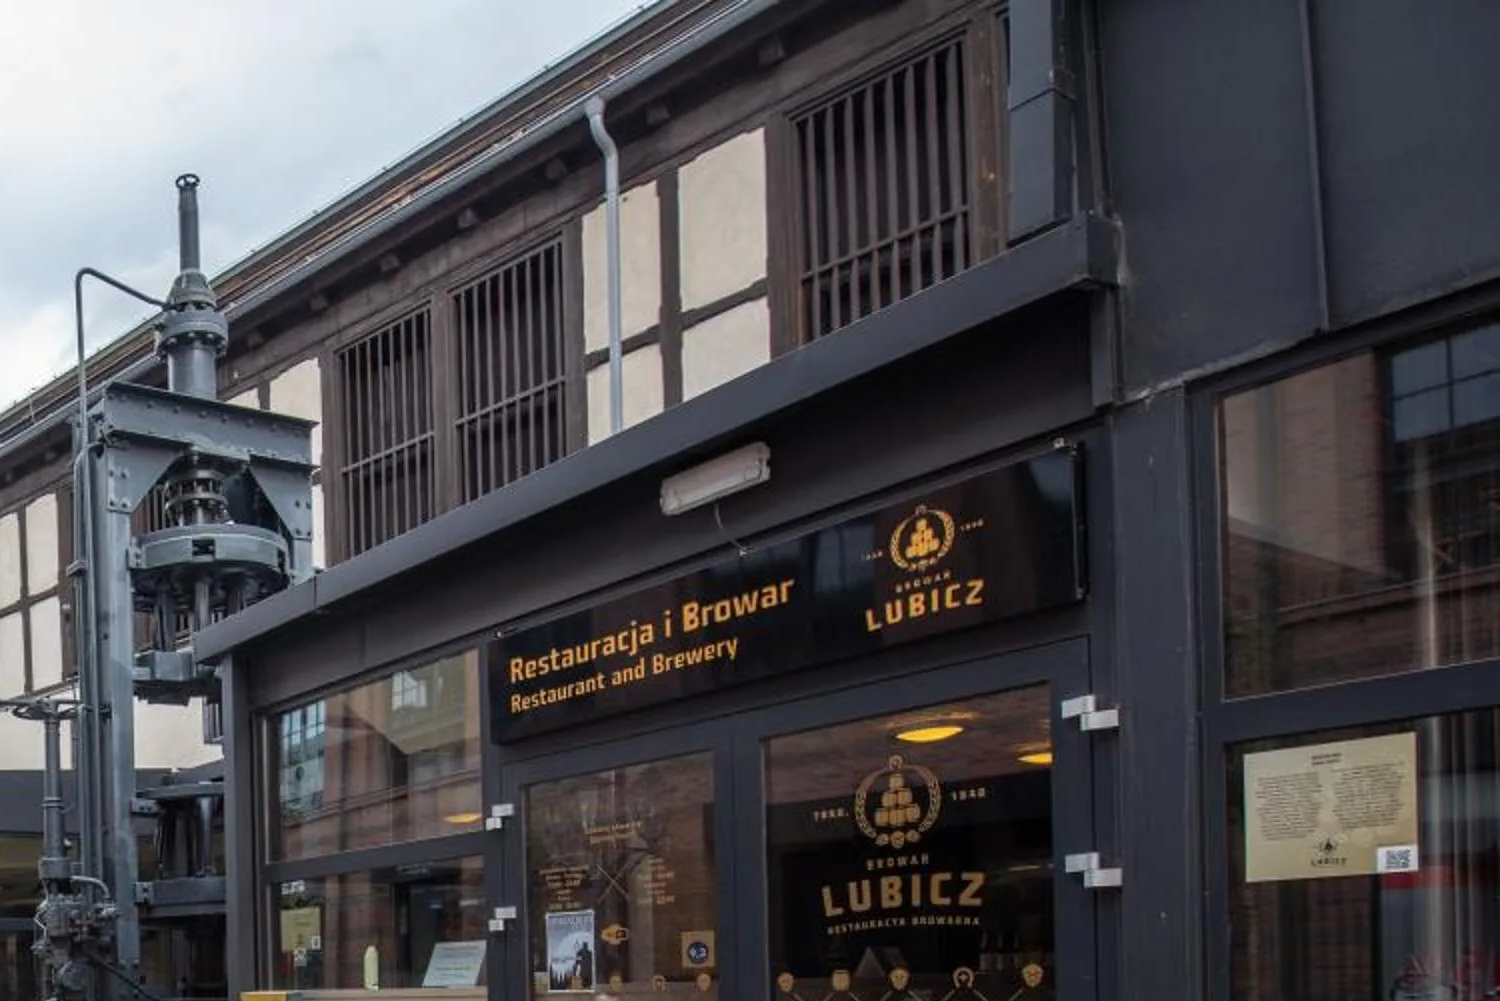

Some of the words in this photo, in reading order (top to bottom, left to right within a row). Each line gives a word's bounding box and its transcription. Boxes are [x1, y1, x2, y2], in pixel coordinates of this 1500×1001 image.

[508, 620, 654, 684] Restauracja
[664, 610, 673, 638] i
[682, 579, 795, 632] Browar
[865, 578, 984, 632] LUBICZ
[510, 672, 606, 713] Restaurant
[611, 657, 646, 686] and
[652, 637, 739, 675] Brewery
[821, 871, 987, 918] LUBICZ
